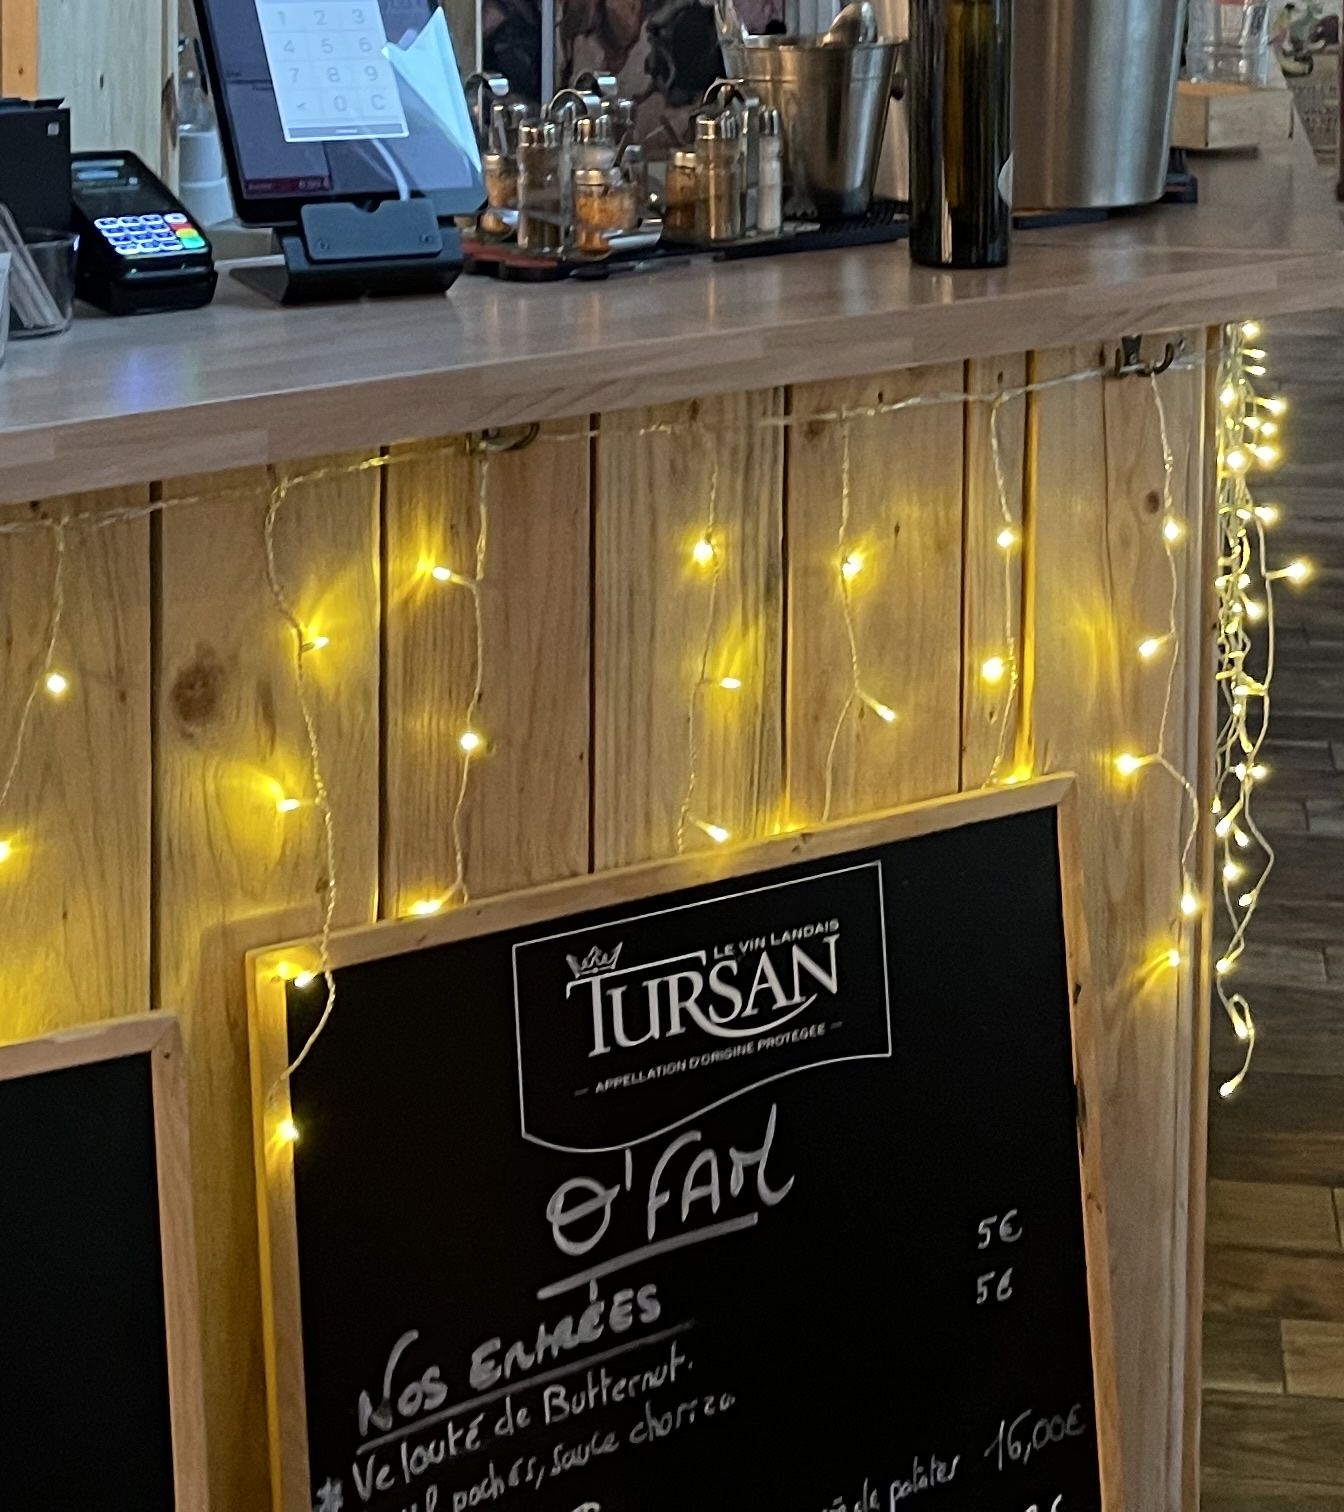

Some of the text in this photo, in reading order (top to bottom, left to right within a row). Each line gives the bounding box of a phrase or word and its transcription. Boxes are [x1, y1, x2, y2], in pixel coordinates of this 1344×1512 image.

[277, 8, 365, 26] 1 2 3
[282, 37, 373, 55] 4 5 6
[289, 65, 379, 83] 7 8 9
[371, 94, 386, 111] C
[713, 918, 841, 961] LE VIN LANDAIS
[565, 932, 841, 1059] TURSAN
[594, 1057, 687, 1095] APPELLATION
[688, 1041, 756, 1071] D'ORIGINE
[977, 1209, 1023, 1250] 5€
[975, 1268, 1013, 1305] 5€
[494, 1394, 532, 1437] de
[550, 1432, 621, 1479] sauce
